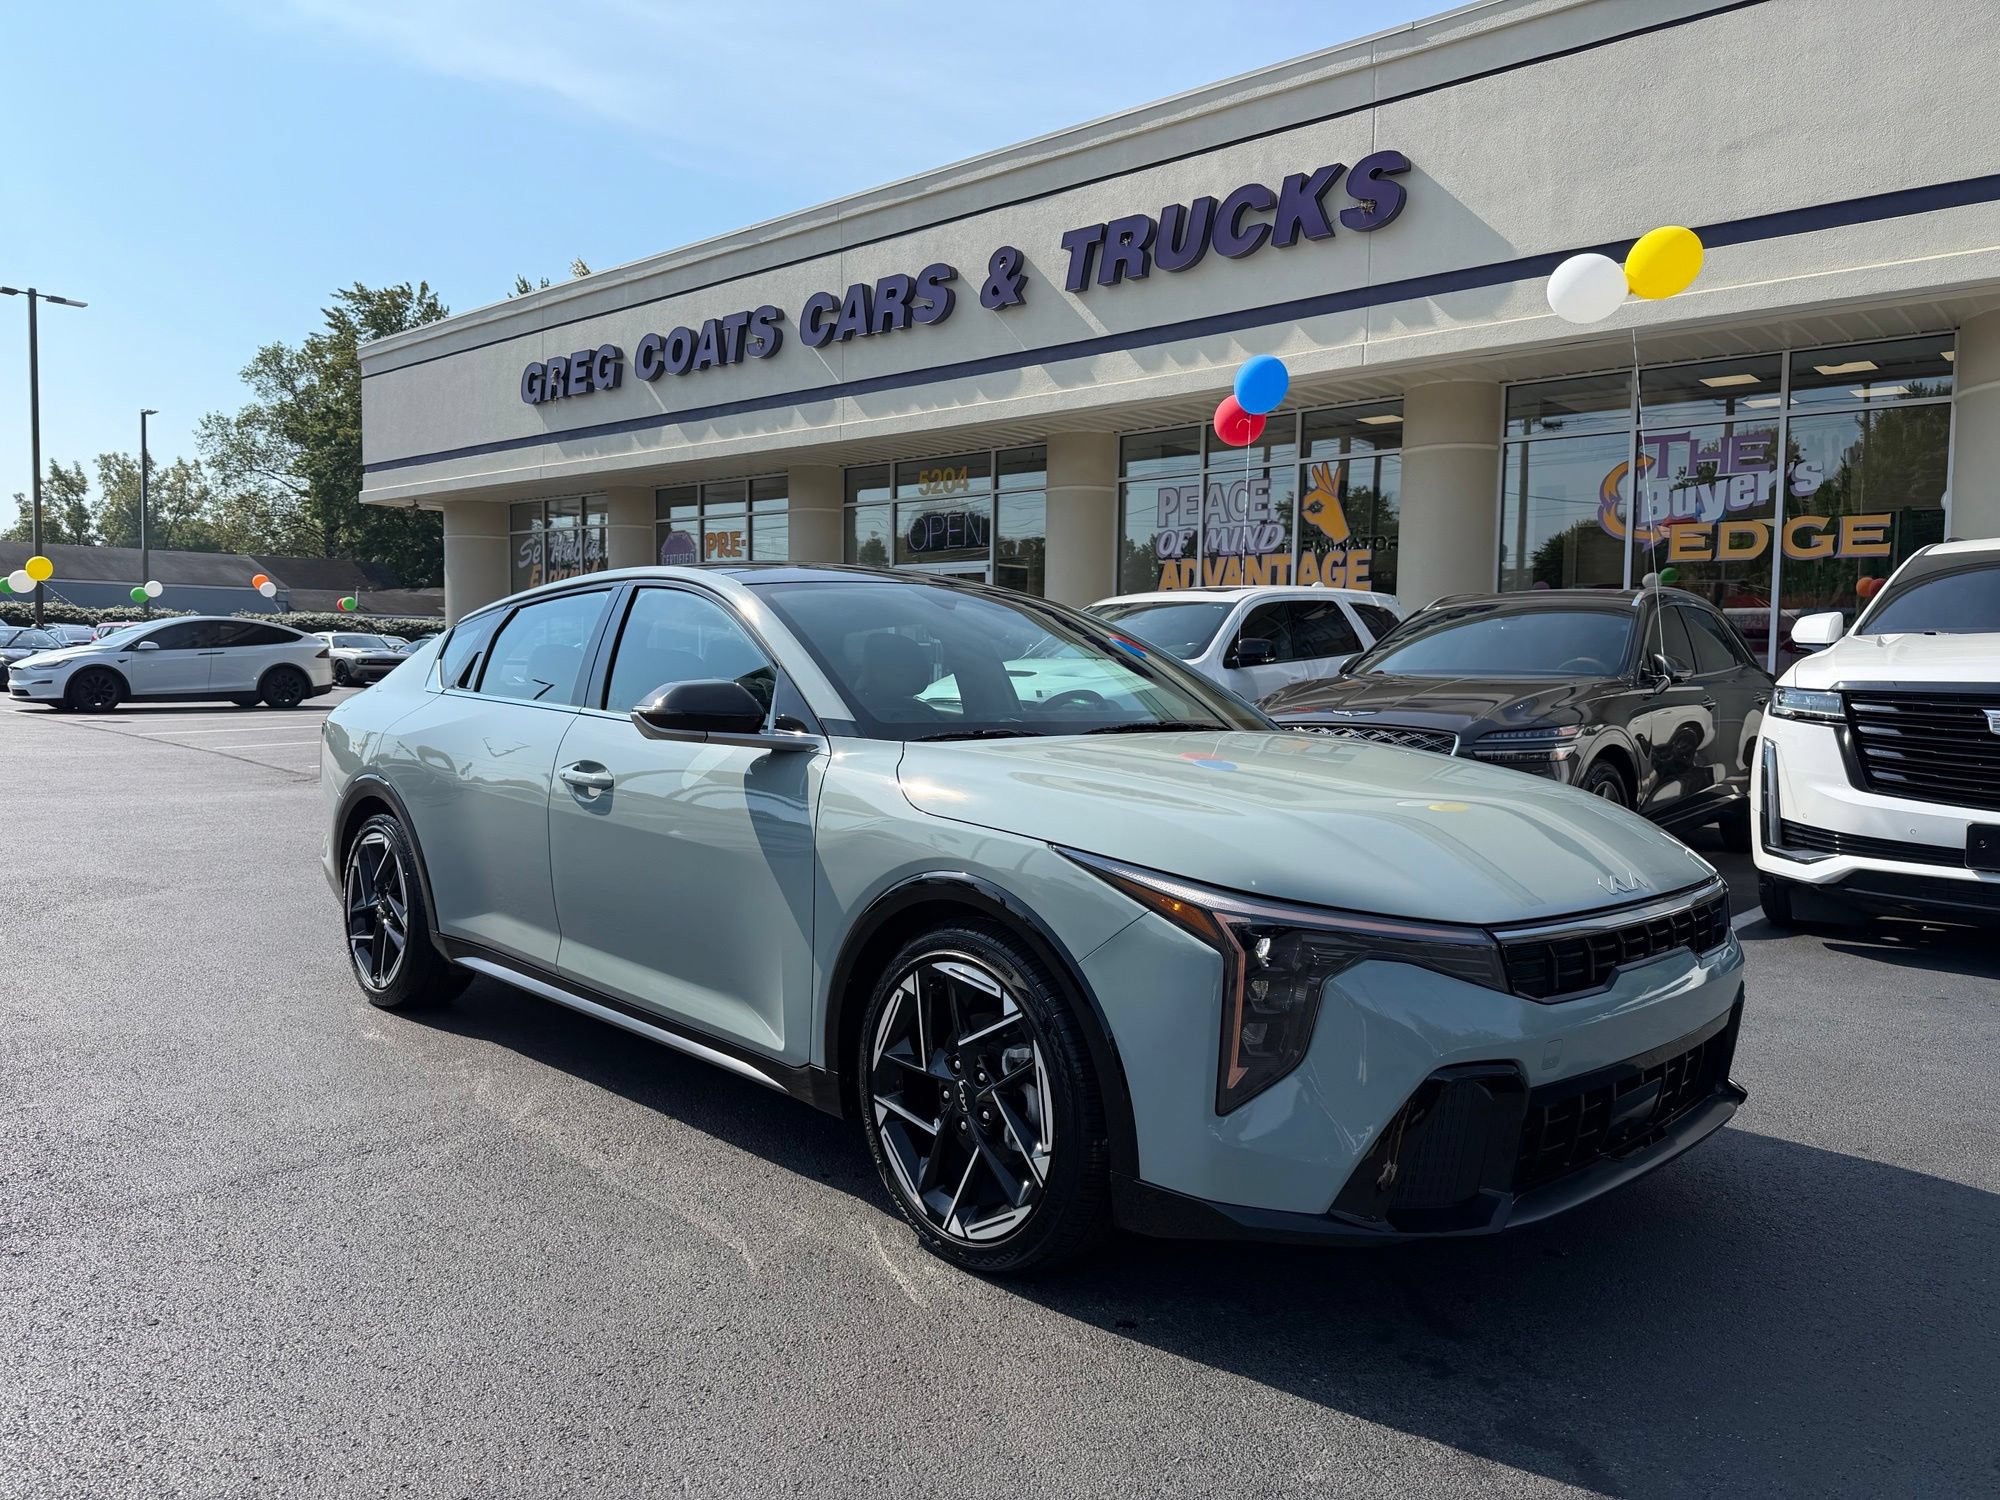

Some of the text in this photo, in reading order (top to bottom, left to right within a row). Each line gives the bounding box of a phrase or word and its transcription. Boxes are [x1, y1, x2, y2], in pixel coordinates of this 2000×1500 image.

[521, 150, 1411, 404] GREG COATS CARS & TRUCKS
[1638, 431, 1773, 481] THE
[918, 465, 970, 496] 5204
[1157, 478, 1271, 528] PEACE
[1637, 460, 1825, 528] Buyer's
[518, 539, 541, 568] Se
[908, 511, 984, 551] OPEN
[1155, 522, 1285, 559] OF MIND
[1667, 512, 1892, 563] EDGE
[1158, 548, 1372, 592] ADVANTAGE
